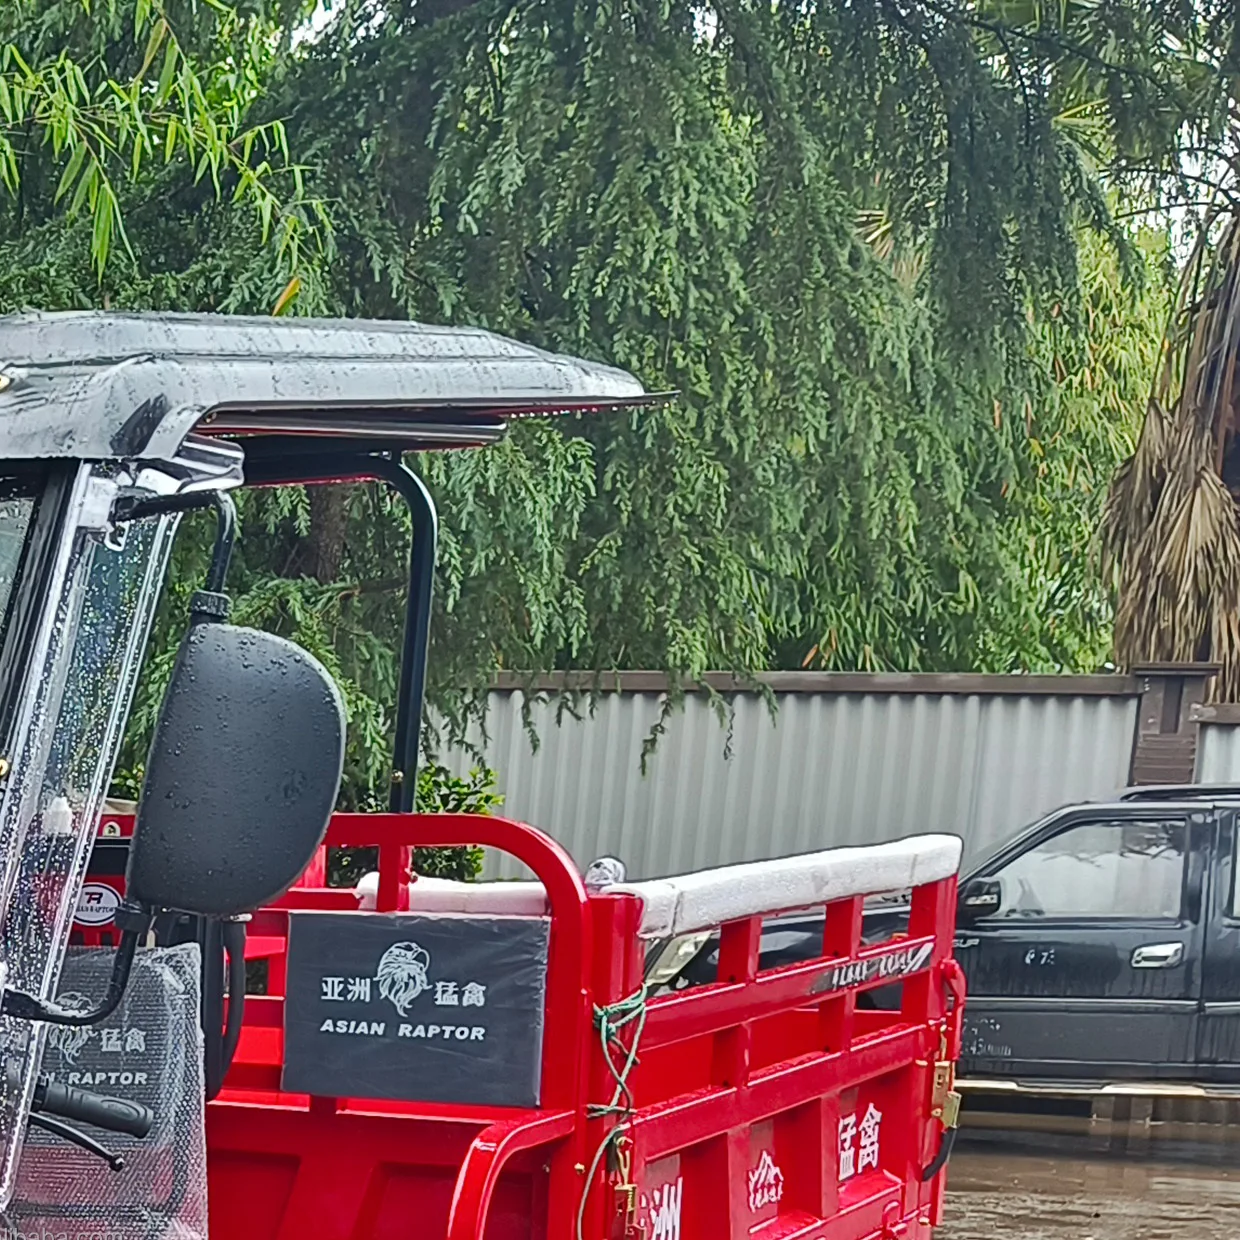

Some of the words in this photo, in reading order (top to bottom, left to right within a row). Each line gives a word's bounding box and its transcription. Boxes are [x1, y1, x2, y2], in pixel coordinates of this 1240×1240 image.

[321, 977, 371, 1003] 亚洲
[434, 981, 487, 1007] 猛禽
[320, 1019, 385, 1036] ASIAN
[398, 1023, 486, 1041] RAPTOR
[68, 1071, 148, 1085] RAPTOR
